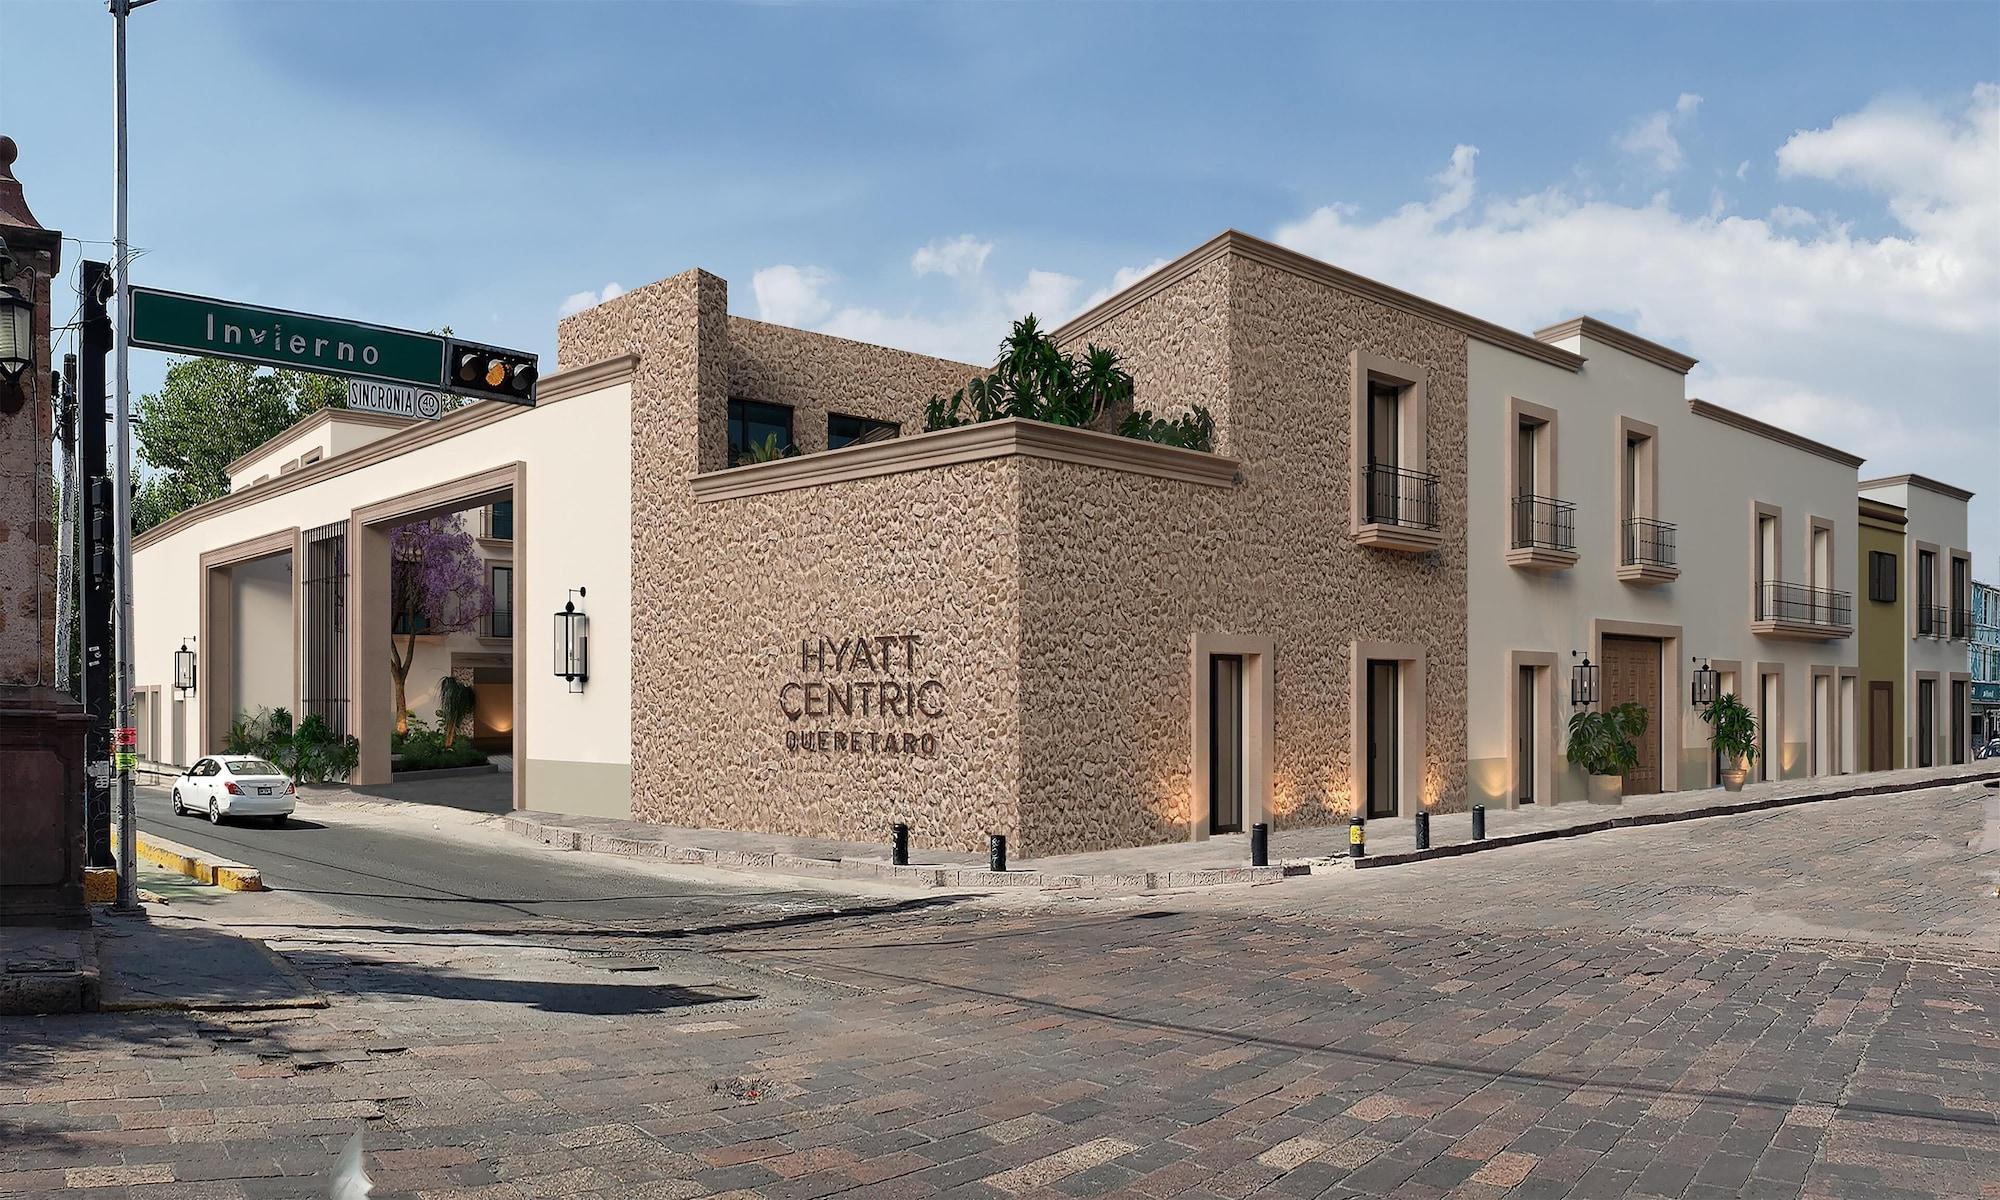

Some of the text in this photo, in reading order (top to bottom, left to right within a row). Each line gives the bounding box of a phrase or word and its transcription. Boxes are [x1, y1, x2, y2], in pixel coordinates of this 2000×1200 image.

[207, 313, 379, 365] Invierno
[351, 382, 413, 413] SINCRONIA
[423, 396, 435, 408] 40
[802, 634, 921, 673] HYATT
[780, 680, 948, 718] CENTRIC
[785, 730, 937, 752] QUERETARO
